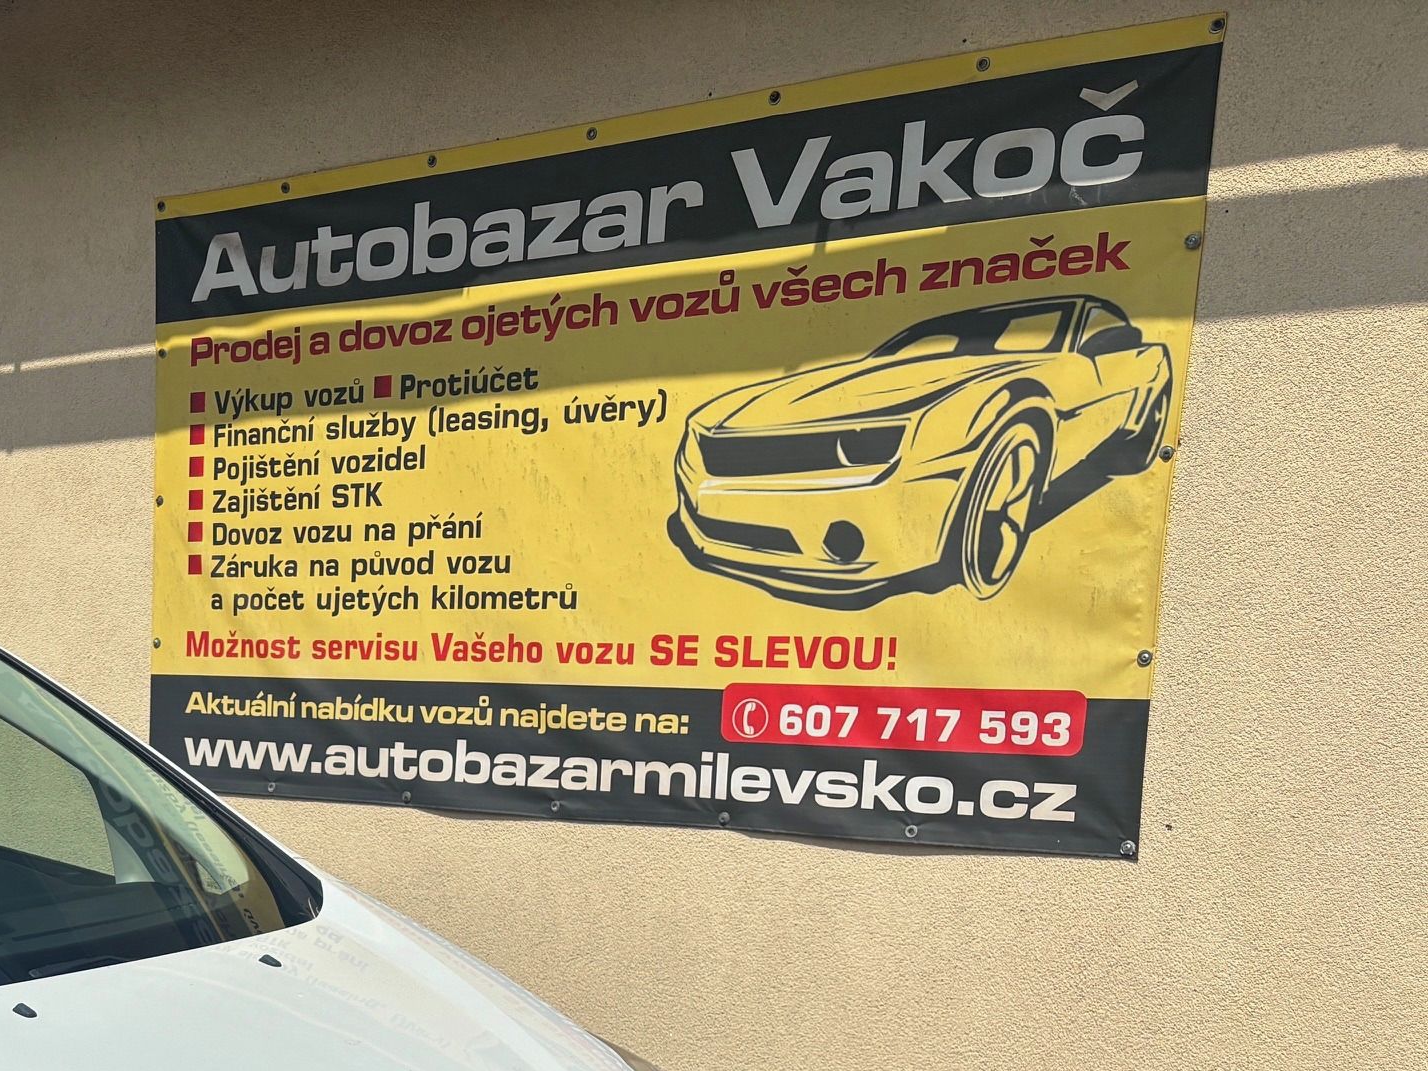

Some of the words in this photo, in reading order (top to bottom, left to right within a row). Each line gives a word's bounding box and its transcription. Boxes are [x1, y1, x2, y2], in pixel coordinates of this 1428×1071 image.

[192, 180, 704, 302] Autobazar
[730, 79, 1145, 230] Vakoč
[190, 327, 301, 367] Prodej
[309, 332, 330, 355] a
[338, 319, 452, 352] dovoz
[462, 293, 618, 347] ojetých
[630, 269, 740, 323] vozů
[752, 258, 906, 308] všech
[919, 232, 1131, 293] značek
[214, 387, 292, 416] Výkup
[305, 378, 365, 409] vozů
[399, 367, 538, 400] Protiúčet
[213, 419, 313, 447] Finanční
[326, 411, 415, 441] služby
[428, 403, 548, 436] (leasing,
[563, 389, 667, 428] úvěry)
[213, 454, 320, 485] Pojištění
[332, 445, 426, 474] vozidel
[212, 486, 320, 517] Zajištění
[332, 482, 383, 508] STK
[212, 521, 282, 546] Dovoz
[293, 523, 351, 544] vozu
[364, 522, 396, 542] na
[408, 512, 483, 546] přání
[210, 550, 298, 577] Záruka
[309, 556, 339, 577] na
[350, 550, 433, 582] původ
[447, 553, 511, 574] vozu
[210, 591, 223, 610] a
[233, 587, 305, 615] počet
[316, 583, 419, 617] ujetých
[431, 583, 577, 610] kilometrů
[186, 629, 300, 659] Možnost
[312, 635, 417, 661] servisu
[431, 632, 543, 663] Vašeho
[556, 641, 635, 665] vozu
[650, 635, 699, 666] SE
[715, 636, 898, 670] SLEVOU!
[185, 691, 296, 718] Aktuální
[301, 694, 415, 724] nabídku
[420, 695, 492, 726] vozů
[500, 704, 627, 734] najdete
[635, 712, 689, 734] na:
[779, 704, 859, 738] 607
[876, 707, 961, 742] 717
[979, 711, 1071, 747] 593
[184, 737, 1077, 823] www.autobazarmilevsko.cz
